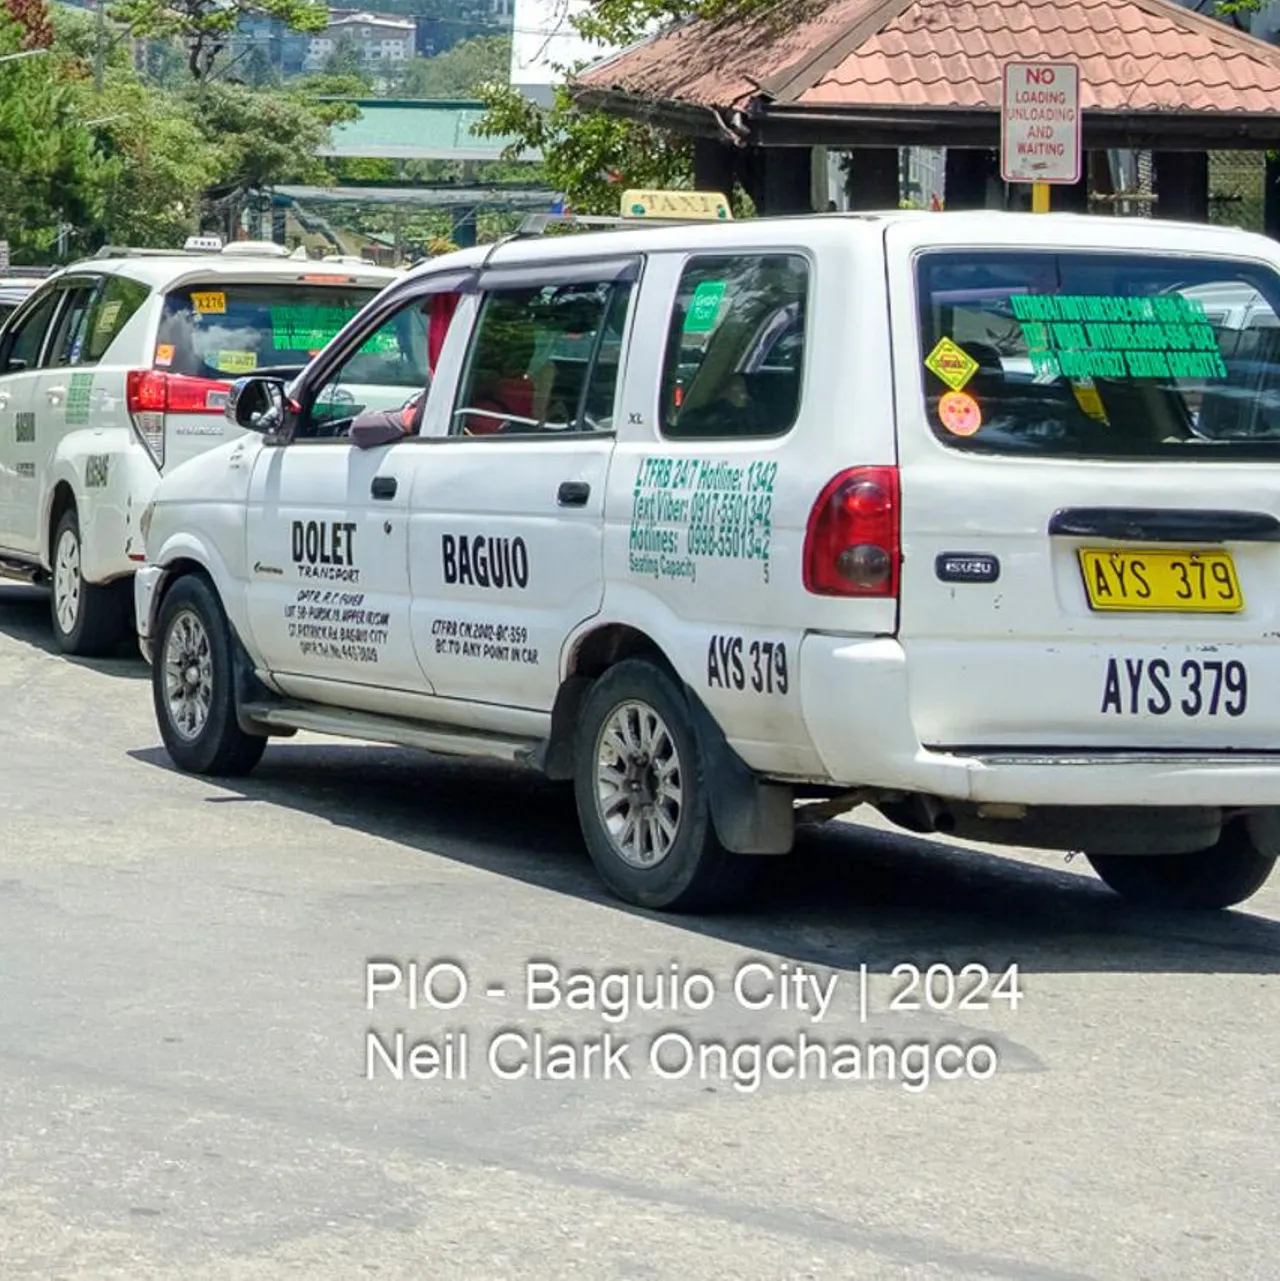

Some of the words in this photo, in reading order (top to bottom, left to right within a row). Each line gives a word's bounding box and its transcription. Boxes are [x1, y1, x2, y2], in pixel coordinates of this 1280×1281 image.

[1026, 68, 1055, 85] NO
[1016, 91, 1065, 105] LOADING
[1007, 107, 1075, 121] UNLOADING
[1027, 125, 1054, 139] AND
[1016, 142, 1065, 156] WAITING
[642, 194, 713, 212] TAXI
[636, 458, 674, 488] LTFRB
[746, 461, 778, 492] 1342
[292, 520, 357, 566] DOLET
[297, 565, 361, 583] TRANSPORT
[1093, 558, 1151, 599] AYS
[1170, 561, 1235, 601] 379
[462, 641, 482, 657] ANY
[483, 643, 510, 660] POINT
[707, 634, 746, 691] AYS
[749, 640, 789, 695] 379
[1100, 657, 1171, 716] AYS
[1180, 659, 1248, 717] 379
